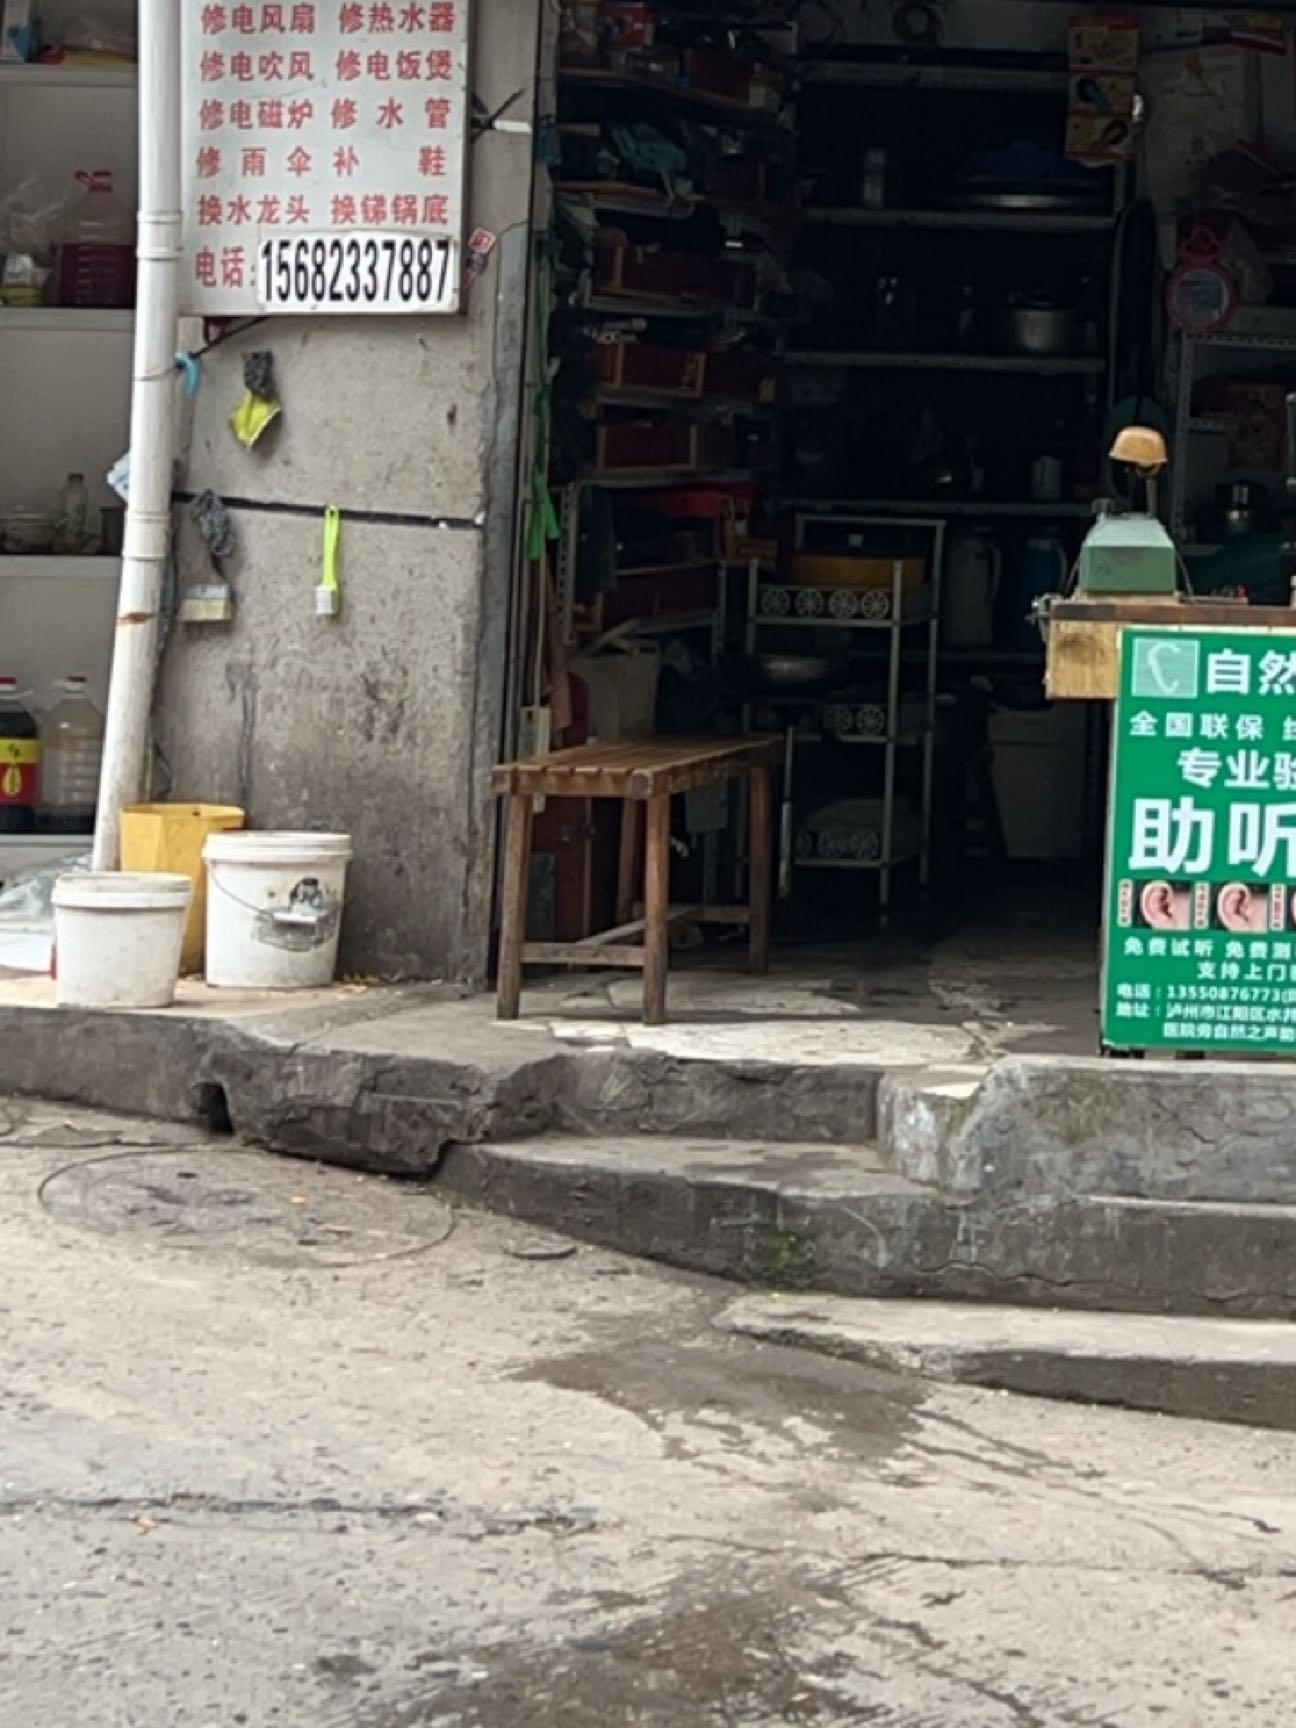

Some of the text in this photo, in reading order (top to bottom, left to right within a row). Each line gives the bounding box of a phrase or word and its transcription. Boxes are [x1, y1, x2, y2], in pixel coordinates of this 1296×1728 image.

[200, 0, 456, 36] 修电风扇 修热水器
[199, 50, 454, 82] 修电吹风 修电饭煲
[199, 98, 315, 132] 修电磁炉
[197, 193, 450, 227] 换水龙头 换锑锅底
[261, 238, 451, 303] 15682337887
[1129, 710, 1265, 741] 全国联保
[1123, 936, 1214, 959] 免费试听
